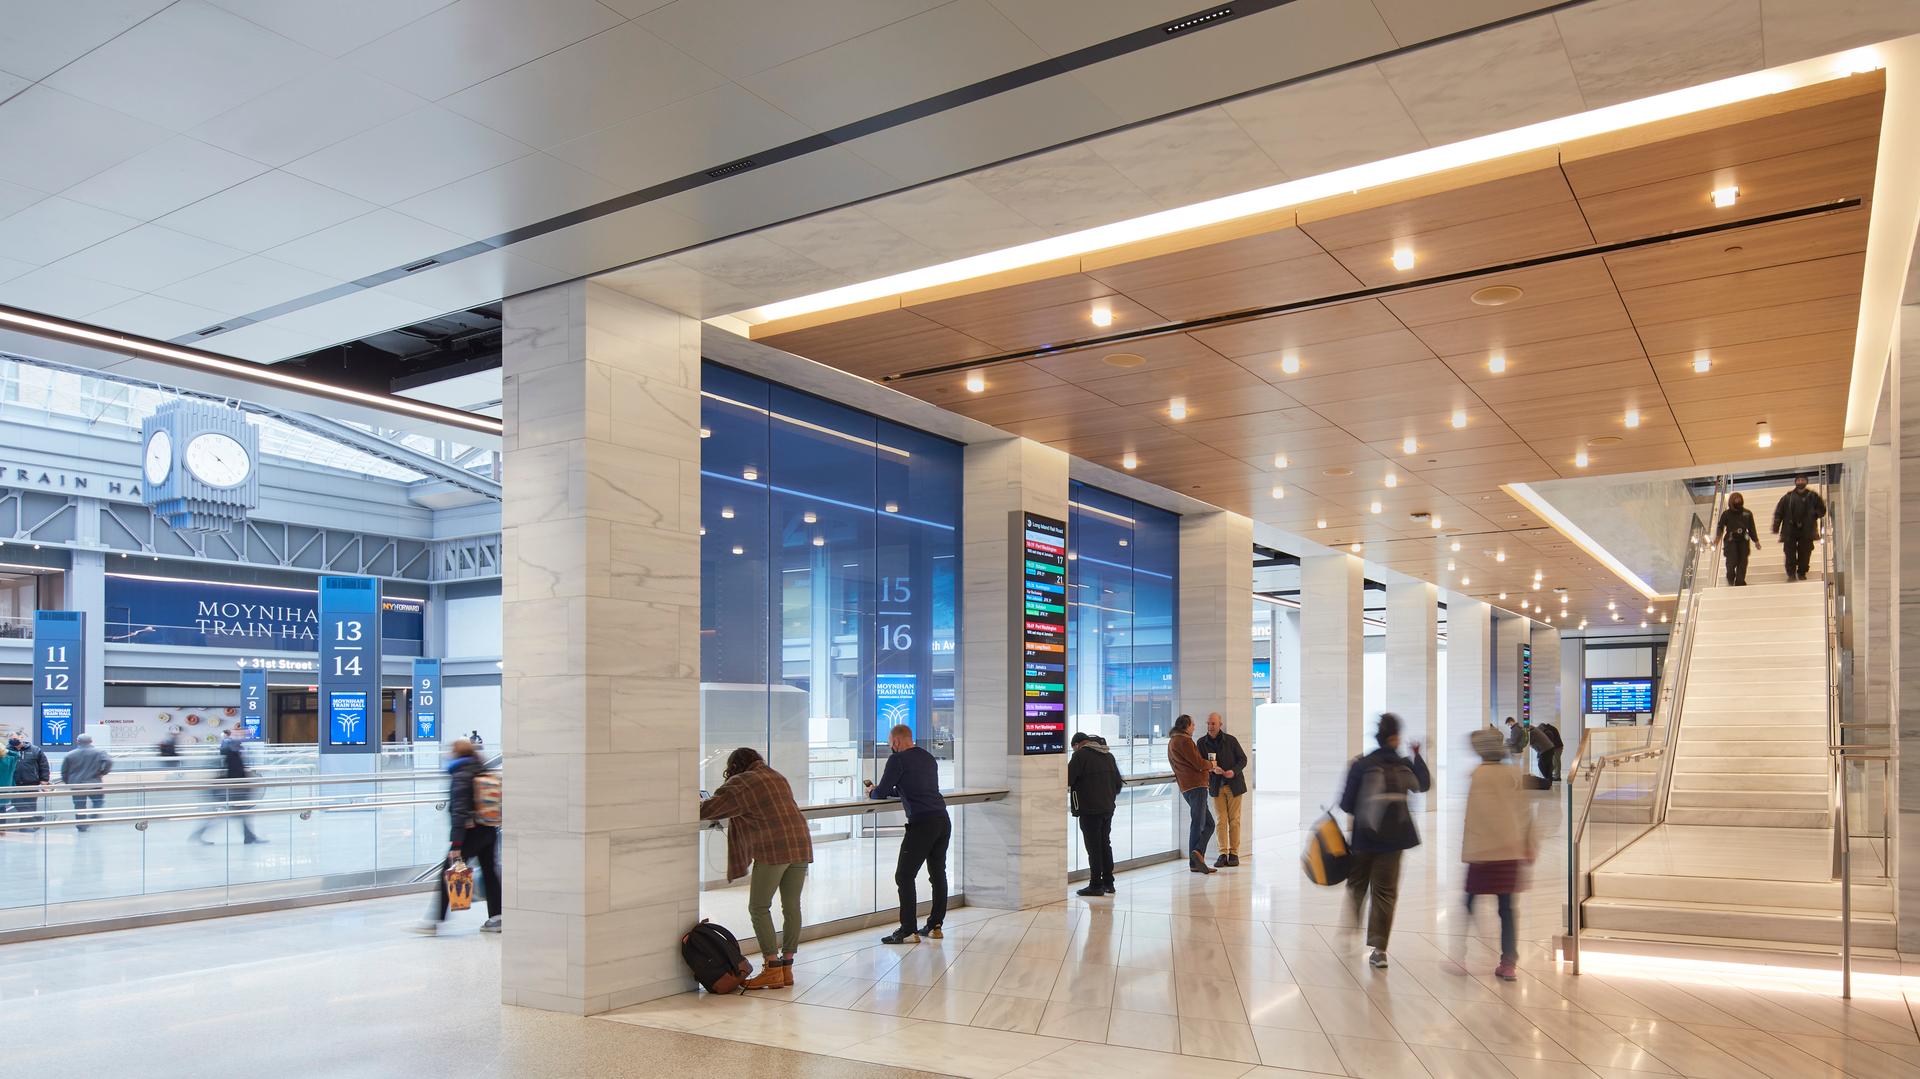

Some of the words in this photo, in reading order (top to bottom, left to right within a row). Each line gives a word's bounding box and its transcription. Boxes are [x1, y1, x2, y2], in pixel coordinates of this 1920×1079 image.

[0, 466, 88, 489] TRAIN
[108, 481, 141, 496] HA
[1057, 556, 1064, 564] 17
[1056, 575, 1063, 584] 21
[881, 577, 911, 603] 15
[198, 601, 318, 623] MOYNIHA
[196, 619, 273, 639] TRAIN
[281, 624, 315, 640] HA
[335, 620, 362, 641] 13
[881, 624, 912, 650] 16
[47, 646, 66, 663] 11
[252, 658, 276, 669] 31st
[279, 659, 312, 670] Street
[334, 655, 362, 676] 14
[45, 673, 69, 691] 12
[422, 679, 431, 689] 9
[249, 686, 257, 696] 7
[249, 700, 257, 710] 8
[420, 695, 433, 706] 10
